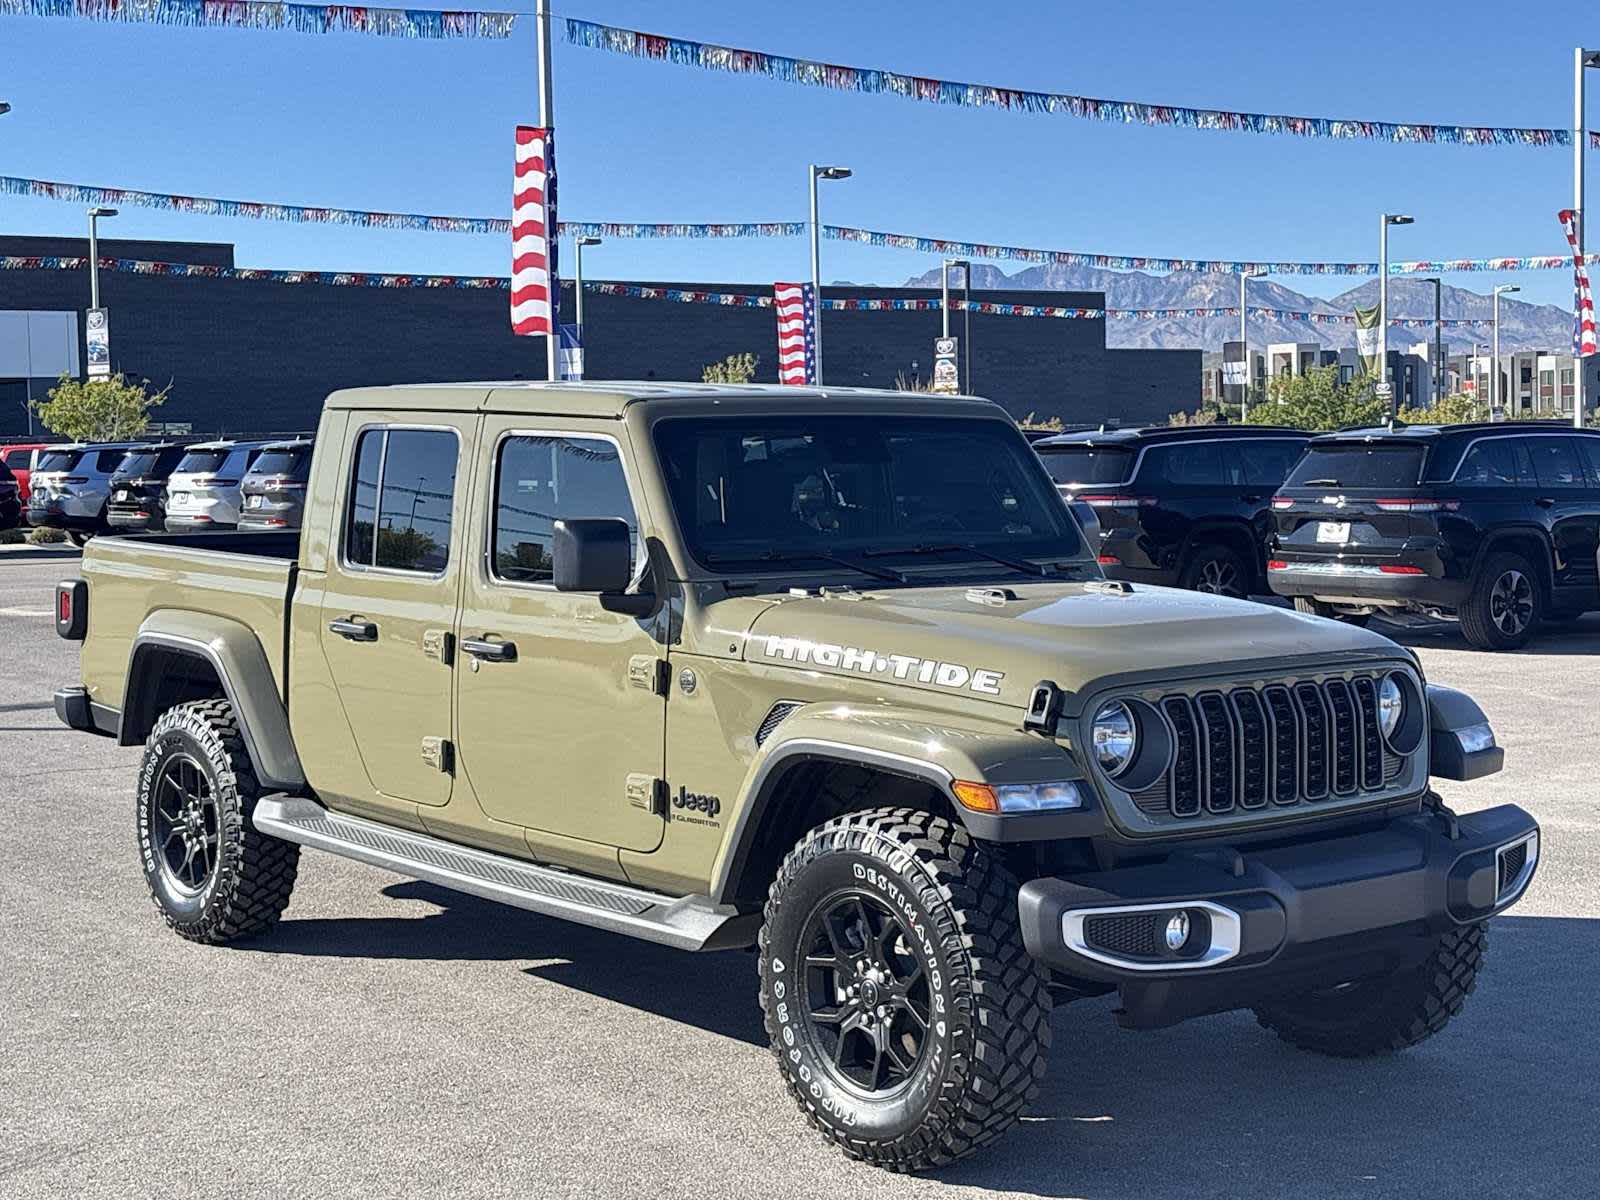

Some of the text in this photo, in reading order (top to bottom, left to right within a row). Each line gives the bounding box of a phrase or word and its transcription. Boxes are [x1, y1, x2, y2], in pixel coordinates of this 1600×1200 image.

[138, 754, 160, 873] DESTINATION
[672, 784, 721, 818] Jeep
[853, 863, 945, 1014] DESTINATION
